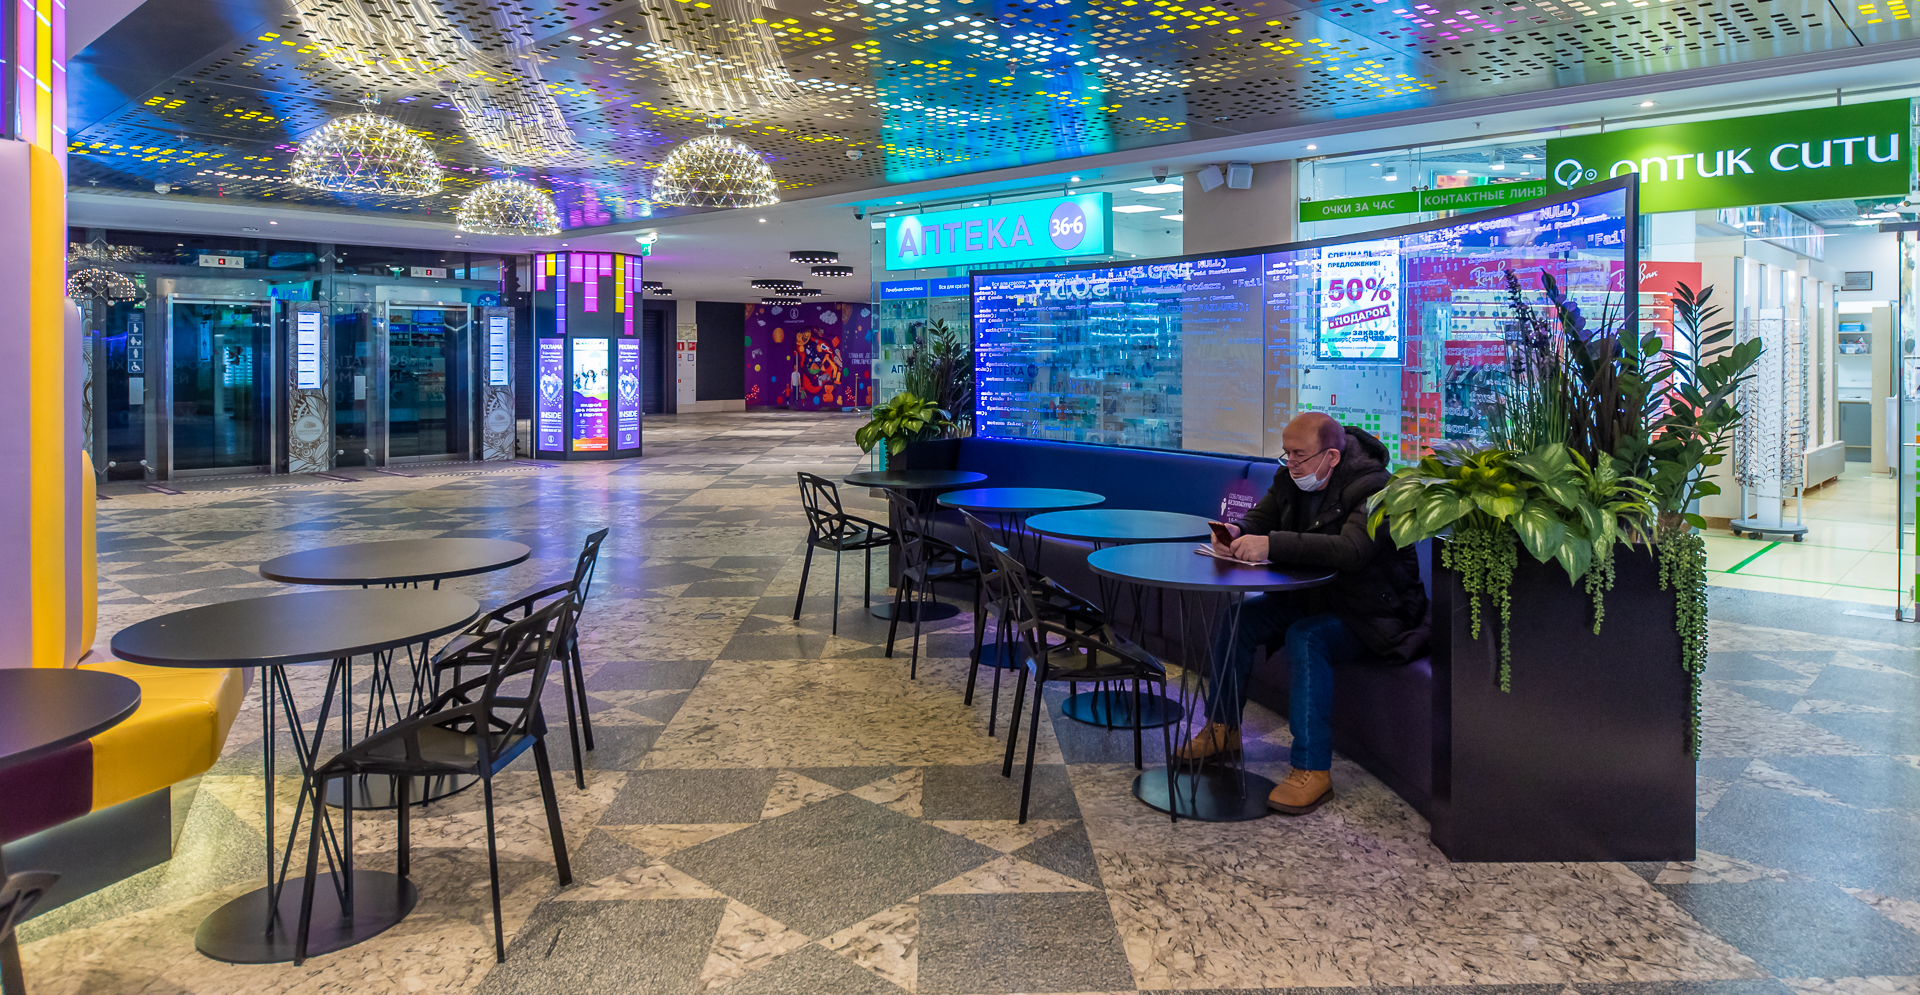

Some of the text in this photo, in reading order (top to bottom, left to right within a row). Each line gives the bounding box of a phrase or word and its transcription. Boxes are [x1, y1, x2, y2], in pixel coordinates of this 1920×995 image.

[1423, 189, 1505, 206] КОНТАКТНЫЕ
[1321, 199, 1395, 215] ОЧКИ ЗА ЧАС
[897, 214, 1034, 258] АПТЕКА
[1327, 260, 1381, 269] ПРЕДЛОЖЕНИЕ!
[885, 286, 903, 294] Лечебная
[955, 282, 970, 290] красот
[1328, 277, 1393, 302] 50%
[1335, 306, 1389, 326] ПОДАРОК
[540, 411, 562, 420] INSIDE
[618, 410, 638, 419] INSIDE
